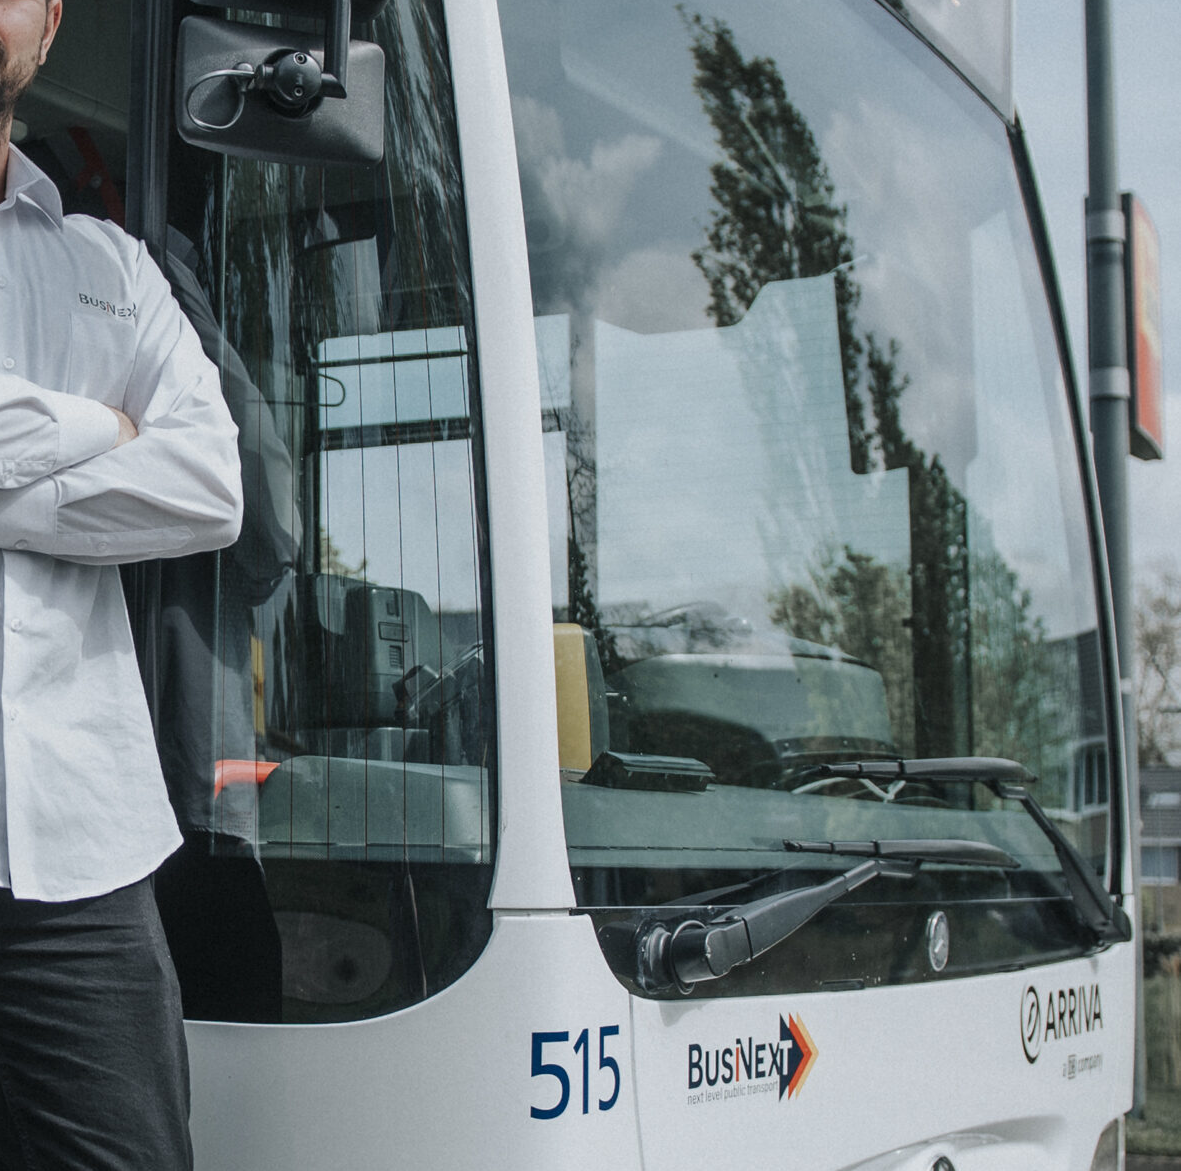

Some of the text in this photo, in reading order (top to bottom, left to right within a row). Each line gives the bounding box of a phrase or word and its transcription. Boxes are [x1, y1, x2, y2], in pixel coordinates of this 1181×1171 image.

[1044, 984, 1103, 1042] ARRIVA
[530, 1025, 621, 1120] 515
[687, 1080, 779, 1106] next level public transport
